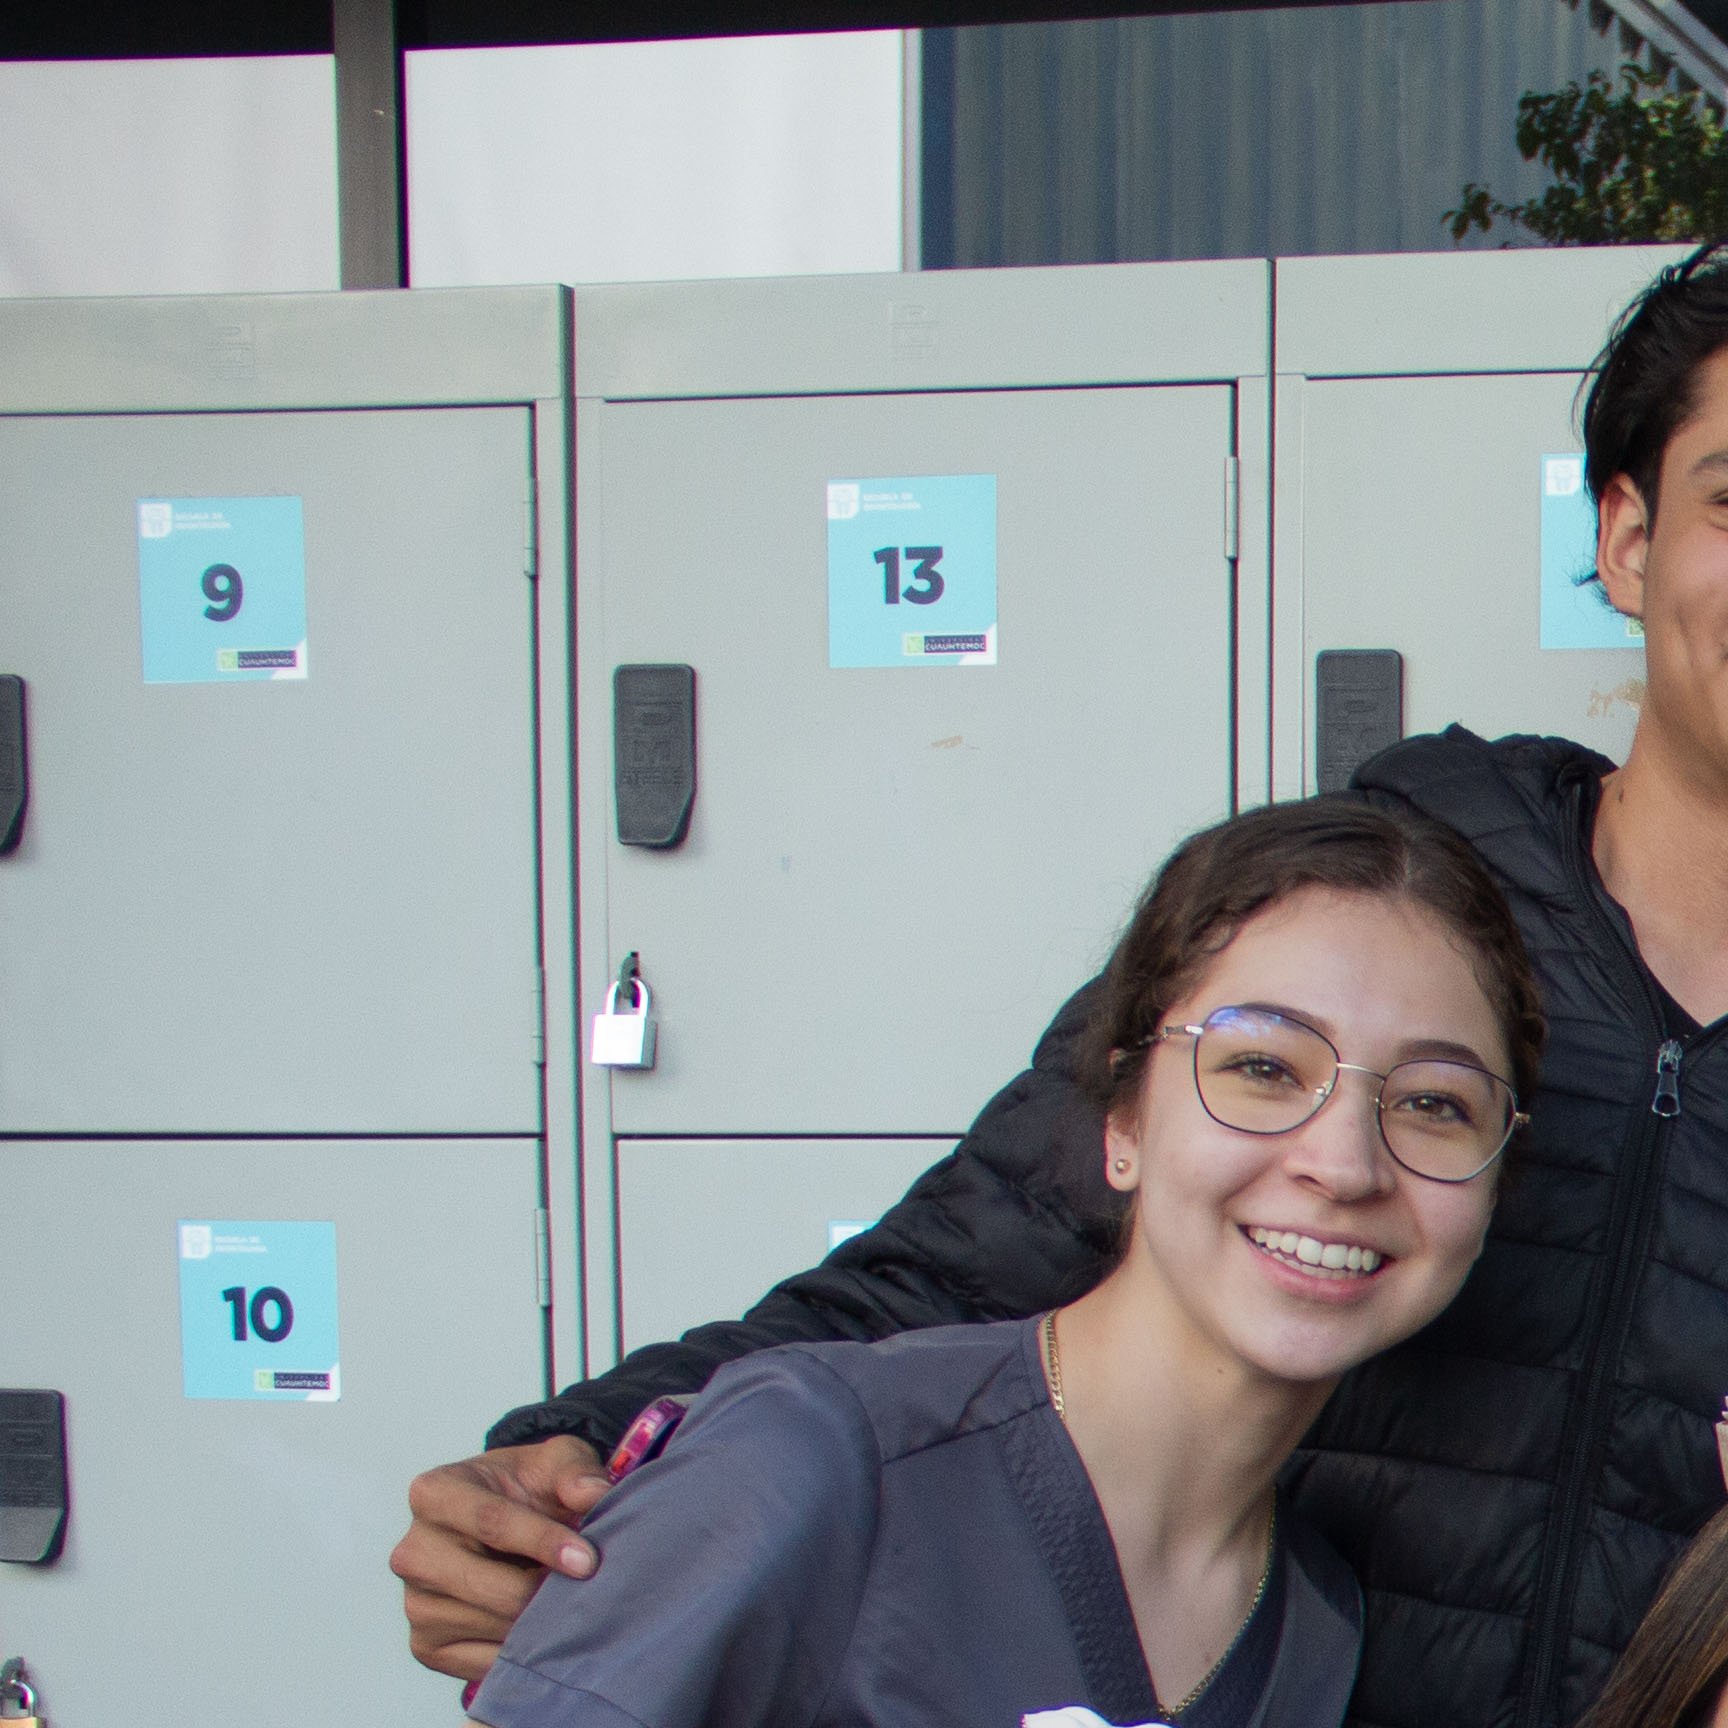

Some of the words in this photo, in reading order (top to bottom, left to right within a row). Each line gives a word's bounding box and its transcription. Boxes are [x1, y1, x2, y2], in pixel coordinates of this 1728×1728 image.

[201, 563, 244, 623] 9
[872, 546, 945, 605] 13
[222, 1286, 294, 1343] 10
